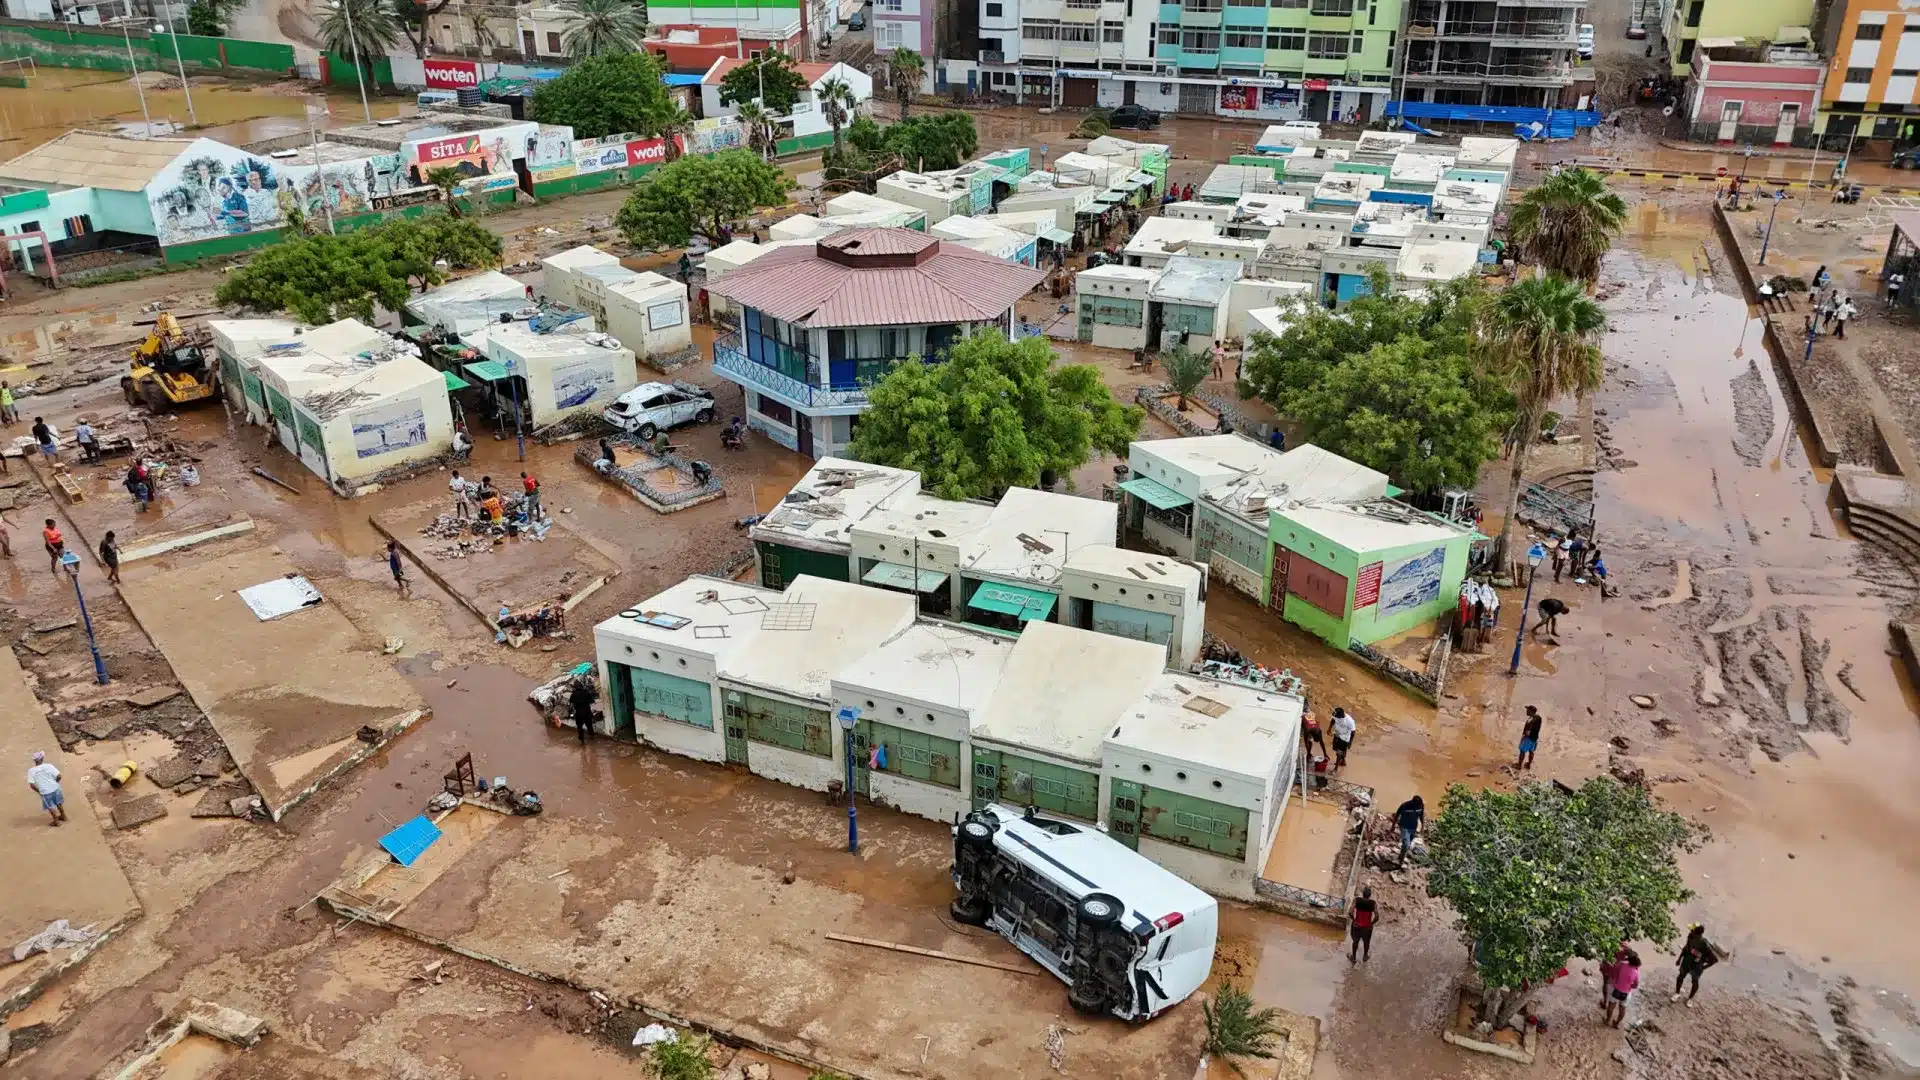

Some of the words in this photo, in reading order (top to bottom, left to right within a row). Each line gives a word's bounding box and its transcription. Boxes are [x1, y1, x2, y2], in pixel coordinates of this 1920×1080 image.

[425, 67, 475, 83] worten
[582, 140, 594, 148] VIP
[633, 142, 667, 160] wort
